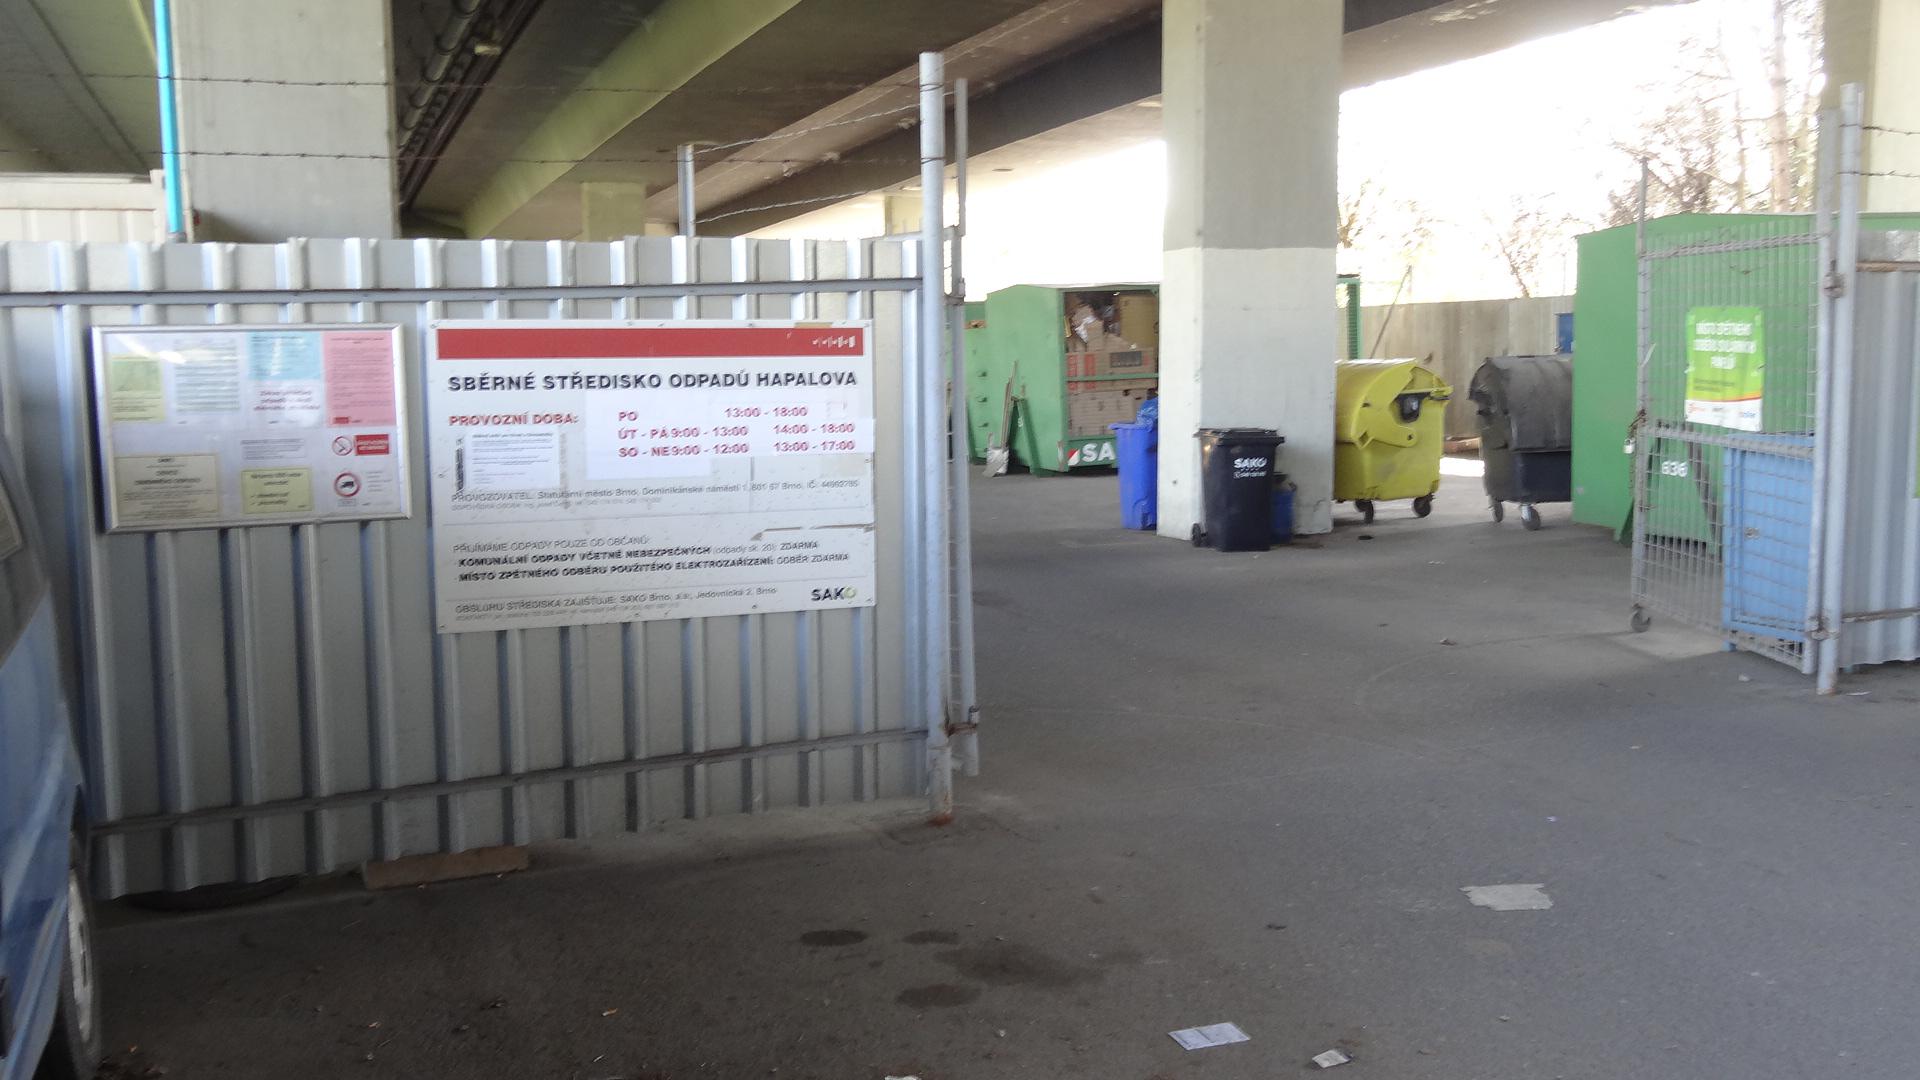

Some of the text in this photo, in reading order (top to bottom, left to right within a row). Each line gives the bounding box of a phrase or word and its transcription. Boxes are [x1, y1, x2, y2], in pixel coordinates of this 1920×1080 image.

[448, 369, 858, 391] SBĚRNÉ STŘEDISKO ODPADŮ HAPALOVA
[449, 411, 580, 426] PROVOZNÍ DOBA:
[618, 411, 639, 421] PO
[725, 407, 761, 418] 13:00
[773, 406, 809, 417] 18:00
[618, 426, 639, 440] ÚT
[650, 425, 670, 439] PÁ
[671, 427, 701, 438] 9:00
[713, 426, 750, 437] 13:00
[774, 424, 810, 435] 14:00
[820, 423, 856, 433] 18:00
[618, 447, 639, 458] SO
[651, 446, 670, 457] NE
[671, 444, 701, 456] 9:00
[713, 443, 750, 454] 12:00
[774, 441, 810, 452] 13:00
[820, 440, 856, 451] 17:00
[1233, 457, 1267, 469] SAKO
[452, 541, 508, 553] PŘIJÍMÁME
[510, 540, 552, 551] ODPADY
[554, 538, 587, 549] POUZE
[590, 537, 605, 547] OD
[459, 554, 528, 567] KOMUNÁLNÍ
[531, 552, 576, 563] ODPADY
[579, 549, 622, 561] VČETNĚ
[625, 544, 711, 558] NEBEZPEČNÝCH
[779, 540, 819, 551] ZDARMA
[459, 552, 850, 582] MÍSTO ZPĚTNÉHO ODBĚRU POUŽITÉHO ELEKTROZAŘÍZENÍ: ODBĚR ZDARMA
[811, 586, 857, 601] SAKO
[456, 602, 504, 614] OBSLUHU
[506, 599, 562, 611] STŘEDISKA
[620, 594, 646, 604] SAKO
